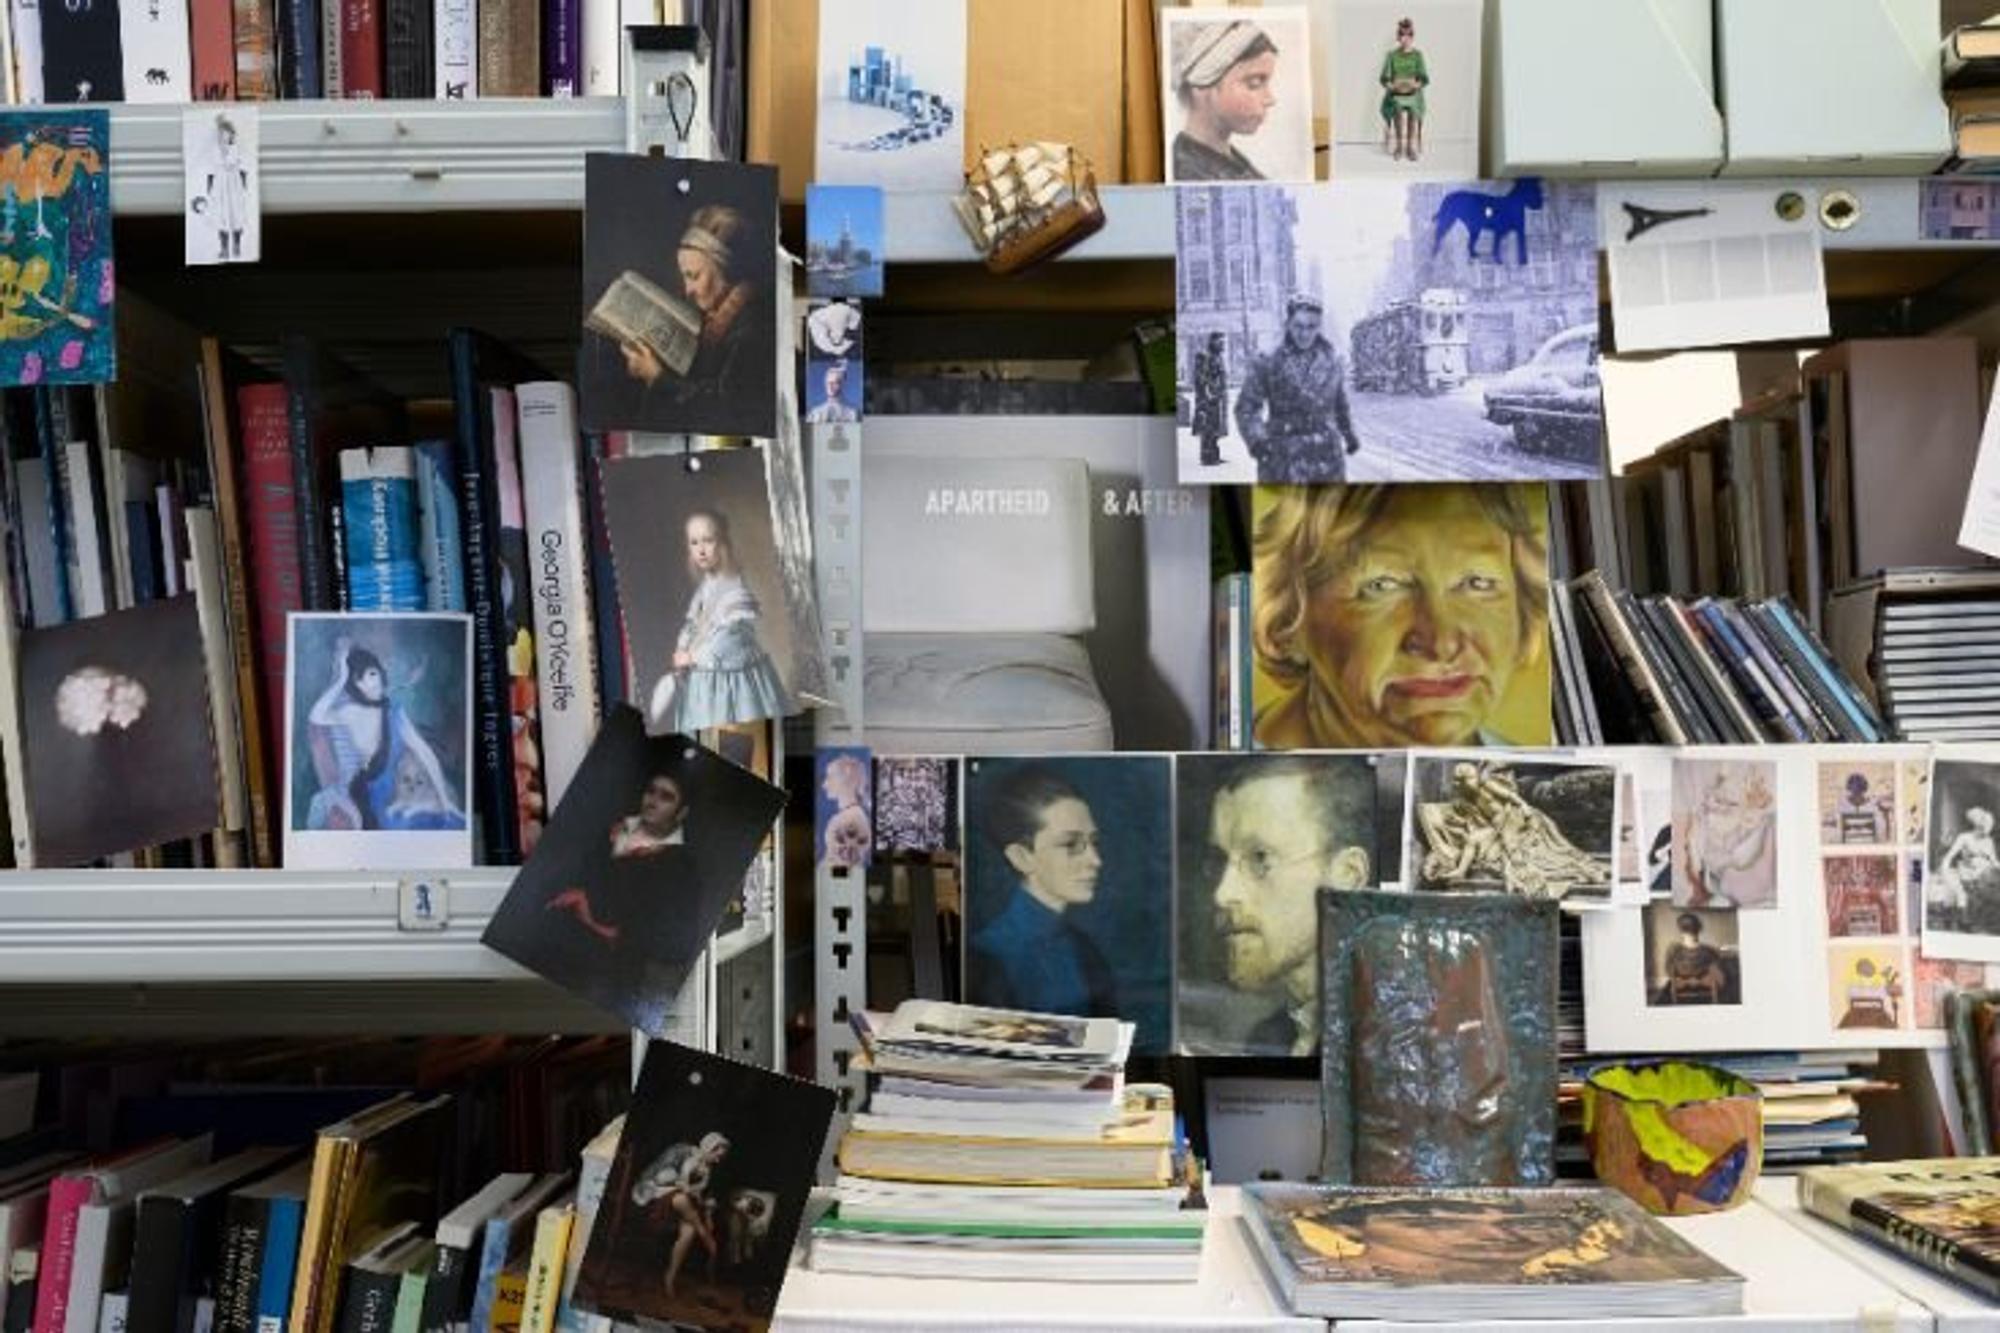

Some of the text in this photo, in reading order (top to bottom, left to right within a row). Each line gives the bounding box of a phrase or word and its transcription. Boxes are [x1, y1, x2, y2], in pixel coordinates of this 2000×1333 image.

[925, 489, 1194, 517] APARTHEID & AFTER
[539, 529, 574, 711] Georgia O'Keeffe
